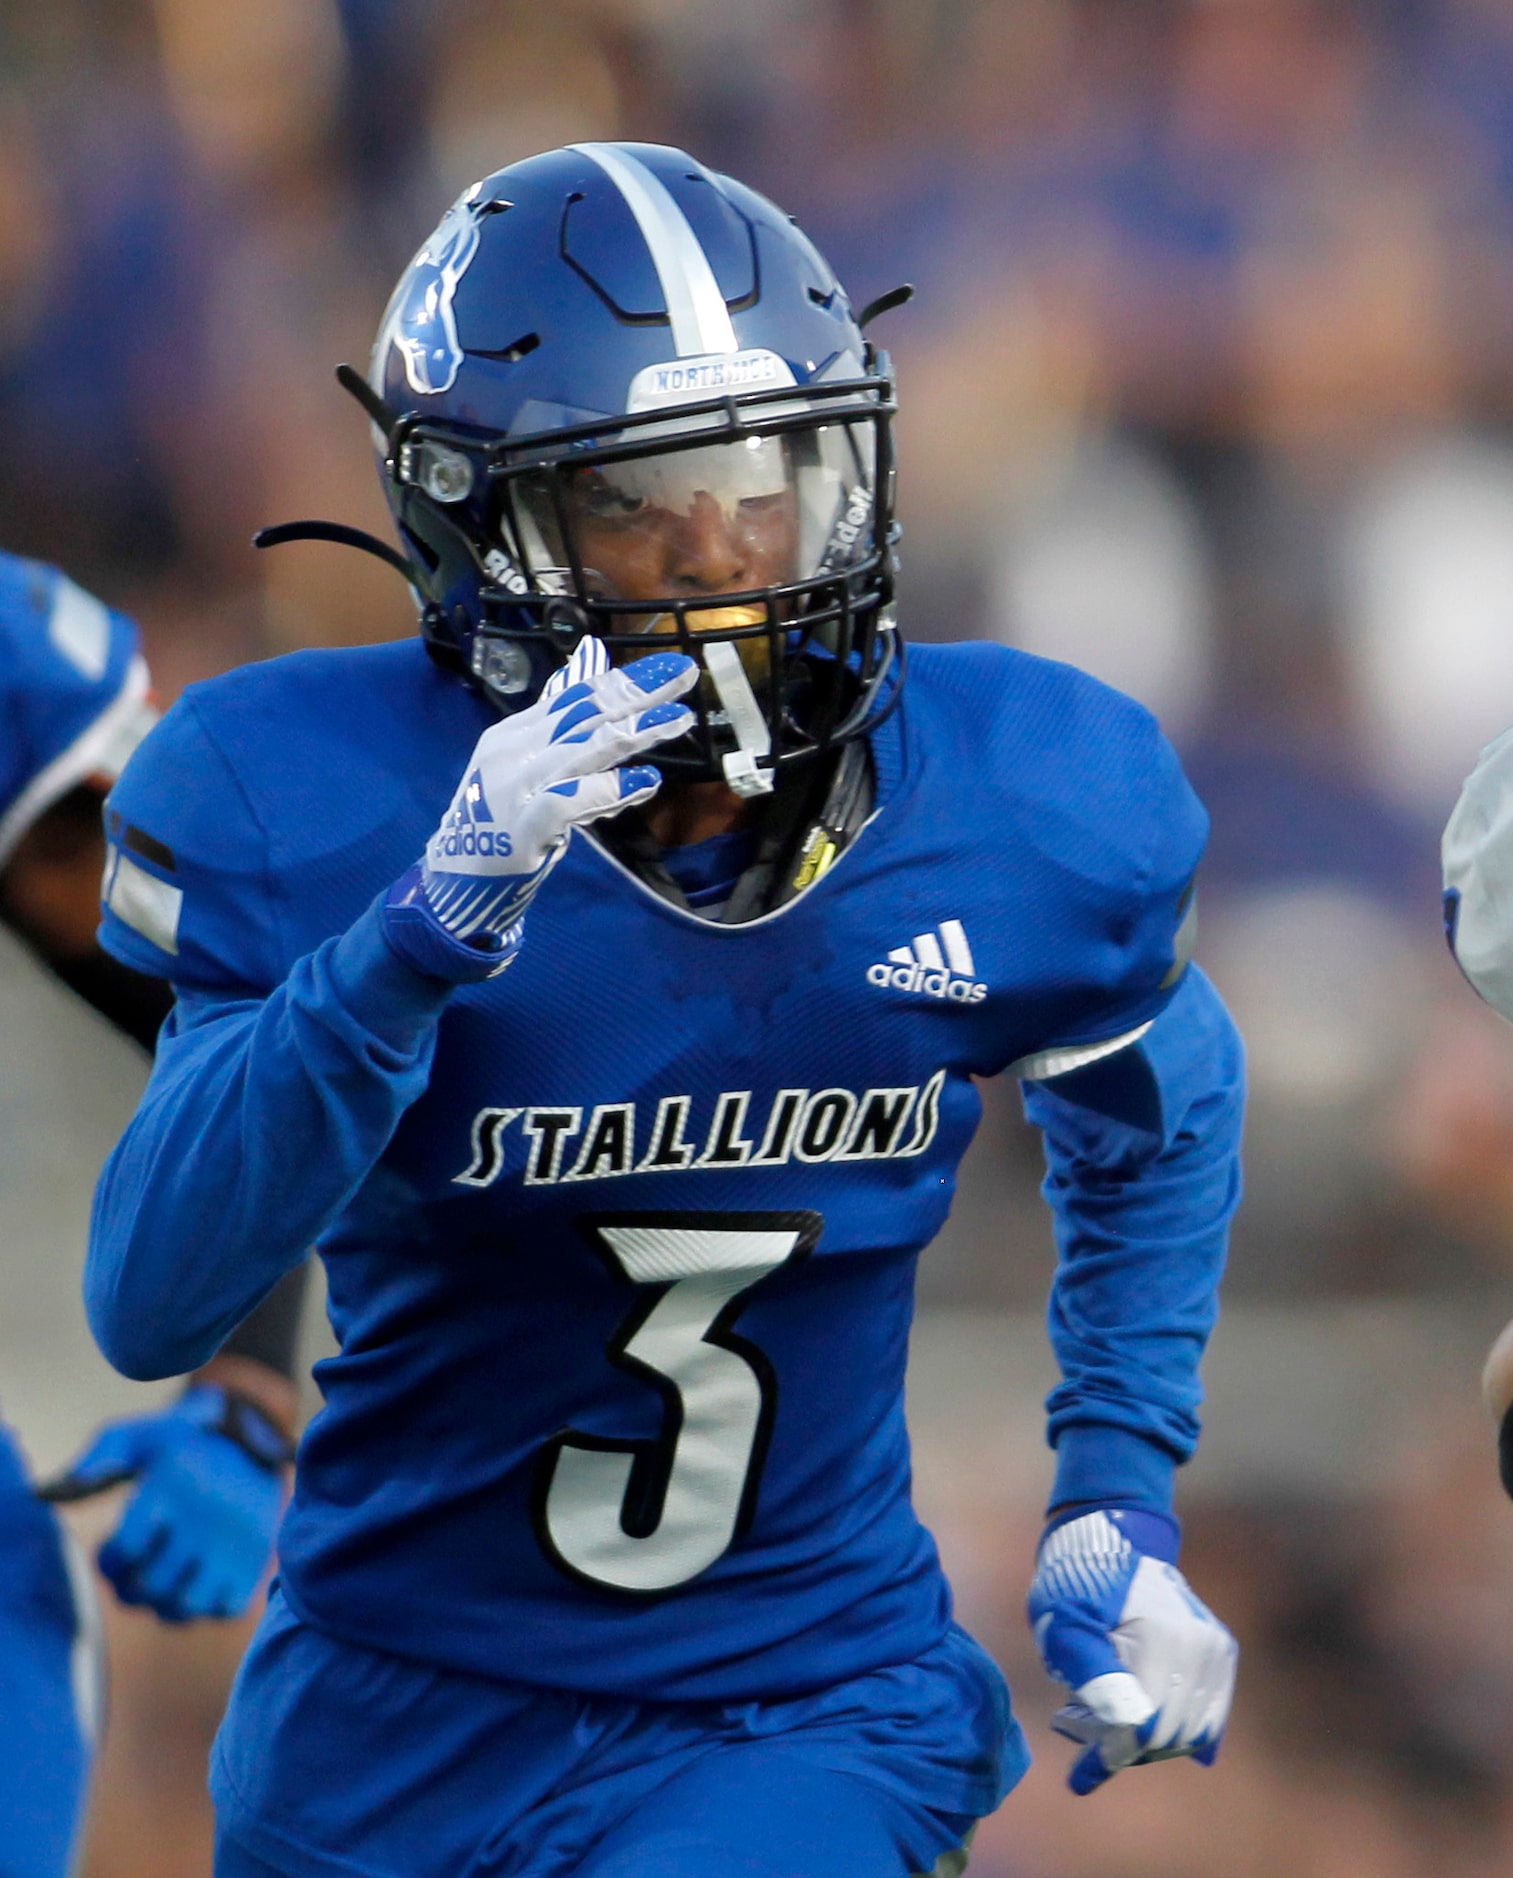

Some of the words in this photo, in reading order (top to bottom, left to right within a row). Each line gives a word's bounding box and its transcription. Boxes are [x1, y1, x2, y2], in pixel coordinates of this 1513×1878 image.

[656, 363, 725, 392] NORTH
[866, 961, 989, 1003] adidas
[451, 1069, 947, 1187] STALLIONS
[528, 1209, 824, 1606] 3
